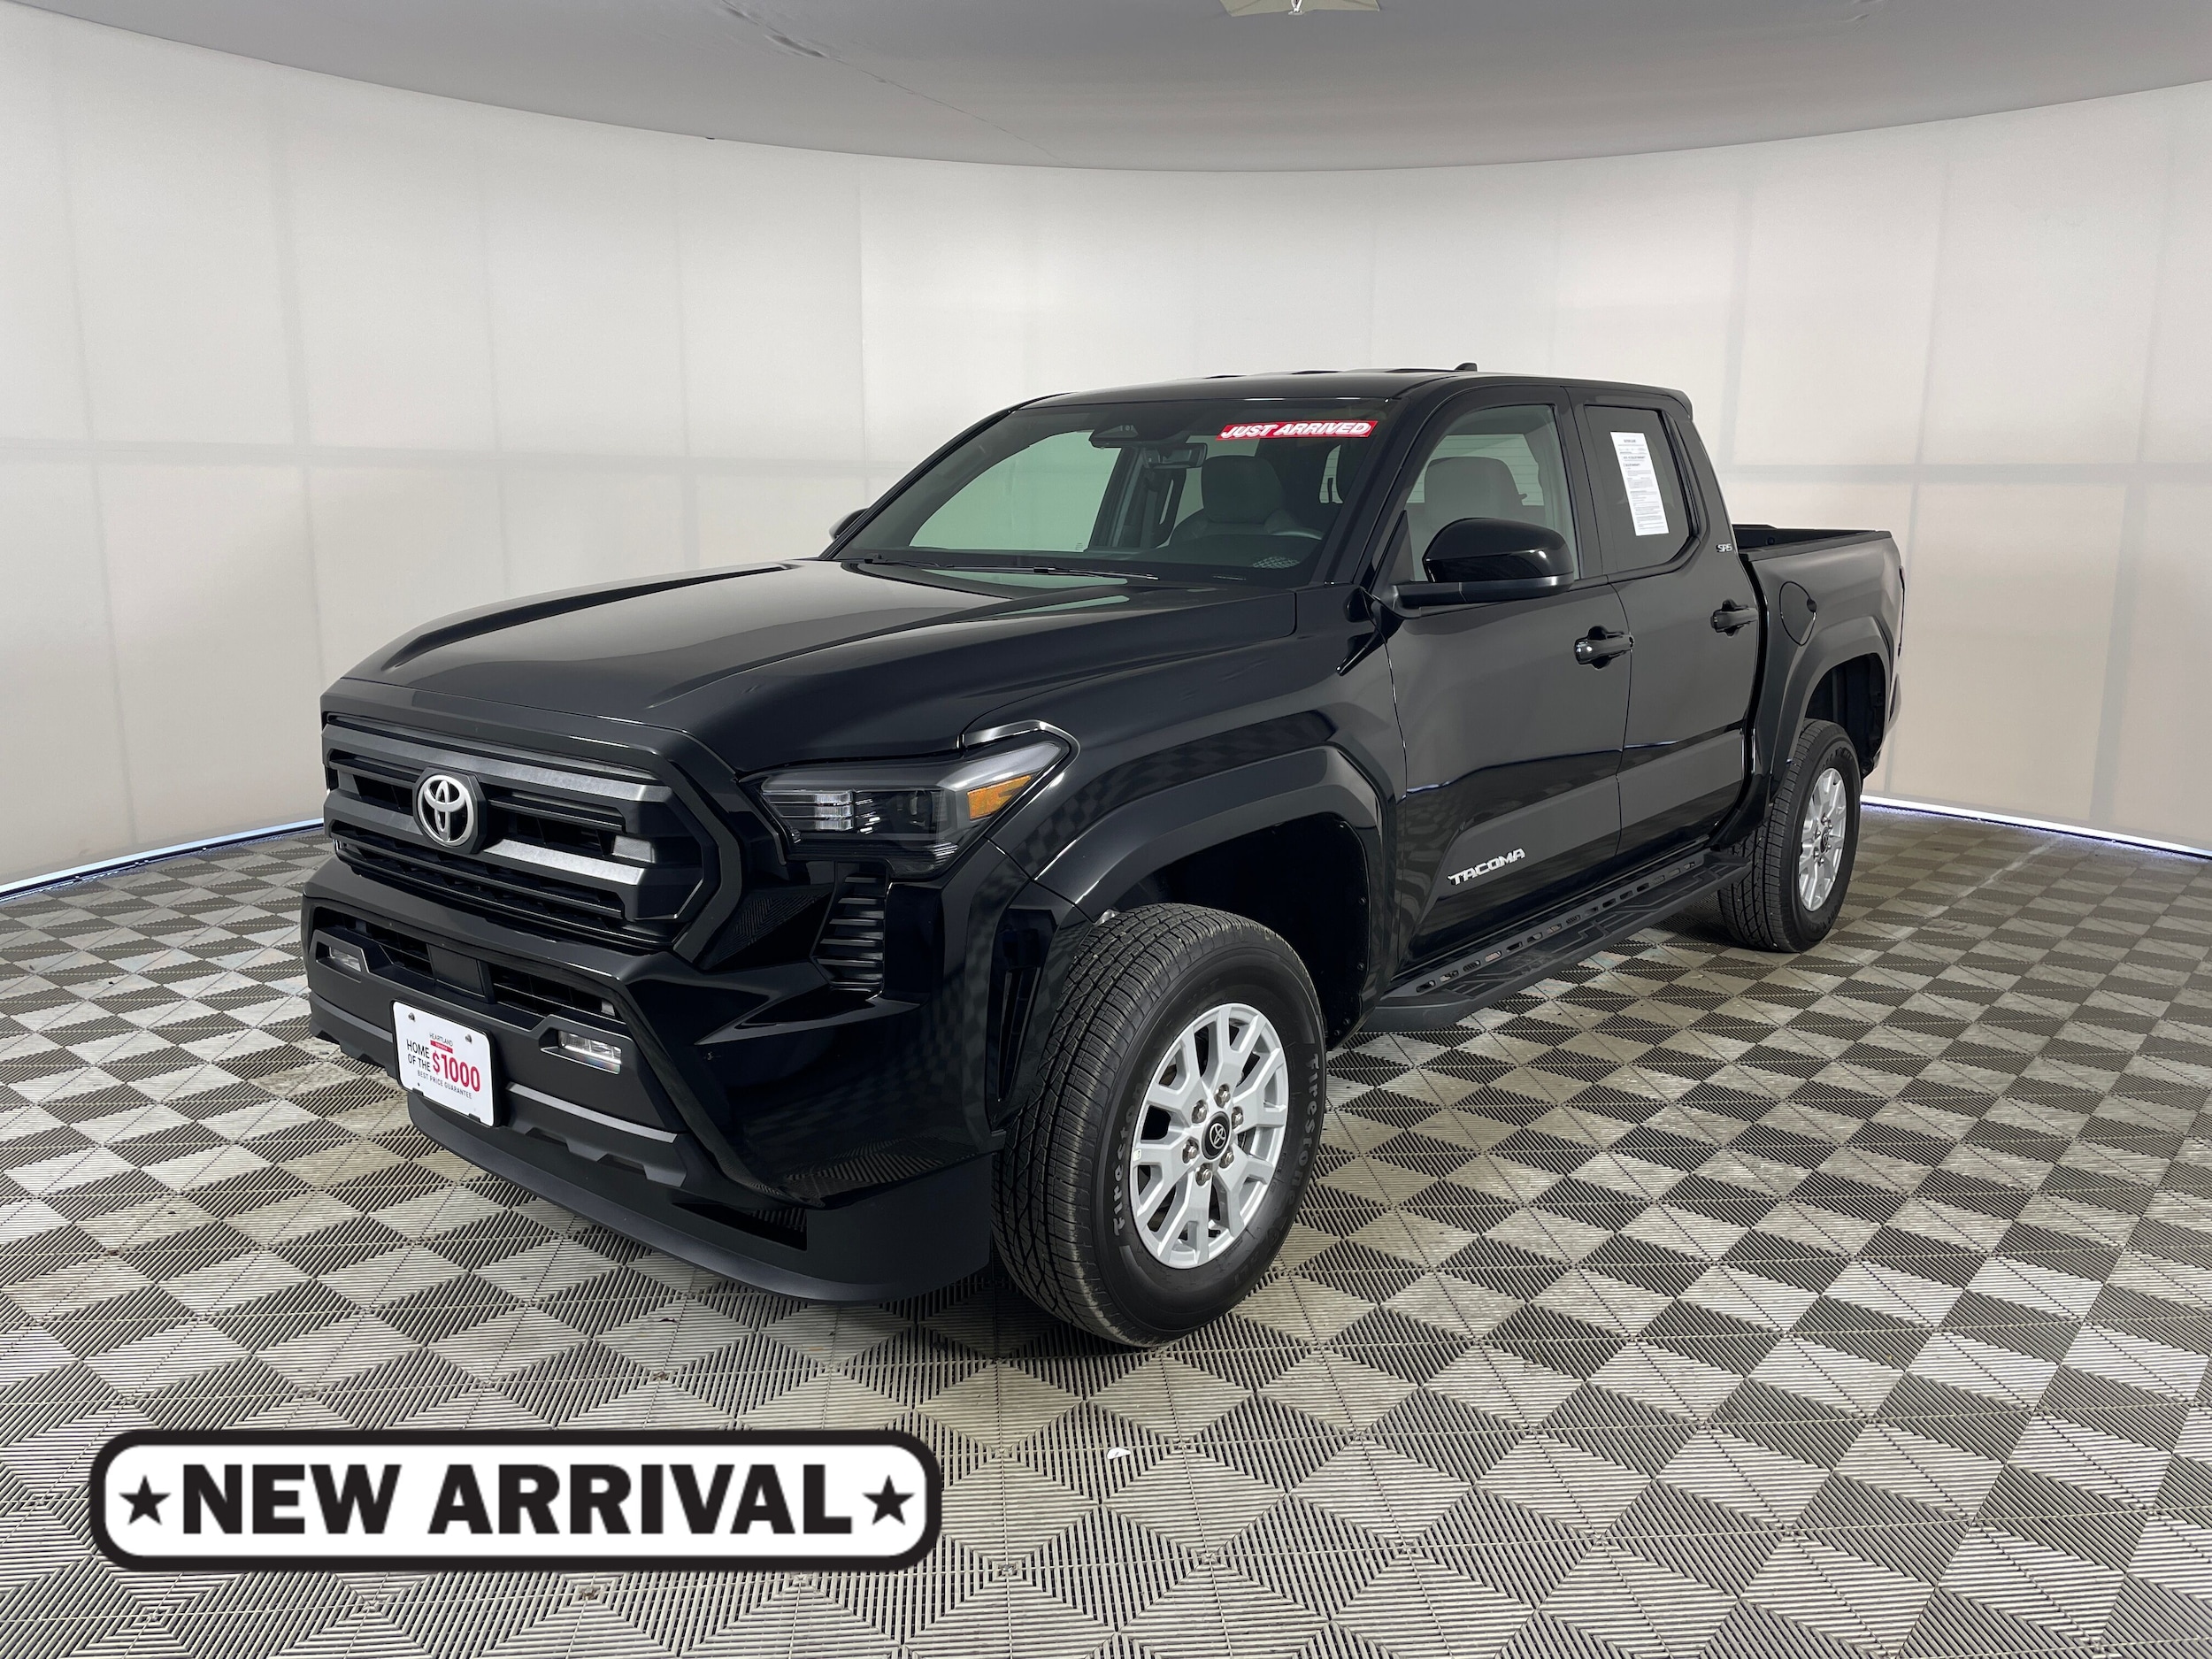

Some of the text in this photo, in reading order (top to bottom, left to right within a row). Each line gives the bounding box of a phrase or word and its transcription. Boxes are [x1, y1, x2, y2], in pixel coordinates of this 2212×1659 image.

[1220, 422, 1371, 439] JUST ARRIVED
[1448, 848, 1525, 886] TACOMA
[406, 1039, 430, 1059] HOME
[407, 1053, 431, 1072] OF THE
[432, 1049, 480, 1093] $1000
[417, 1069, 472, 1100] BEST PRICE GUARANTEE
